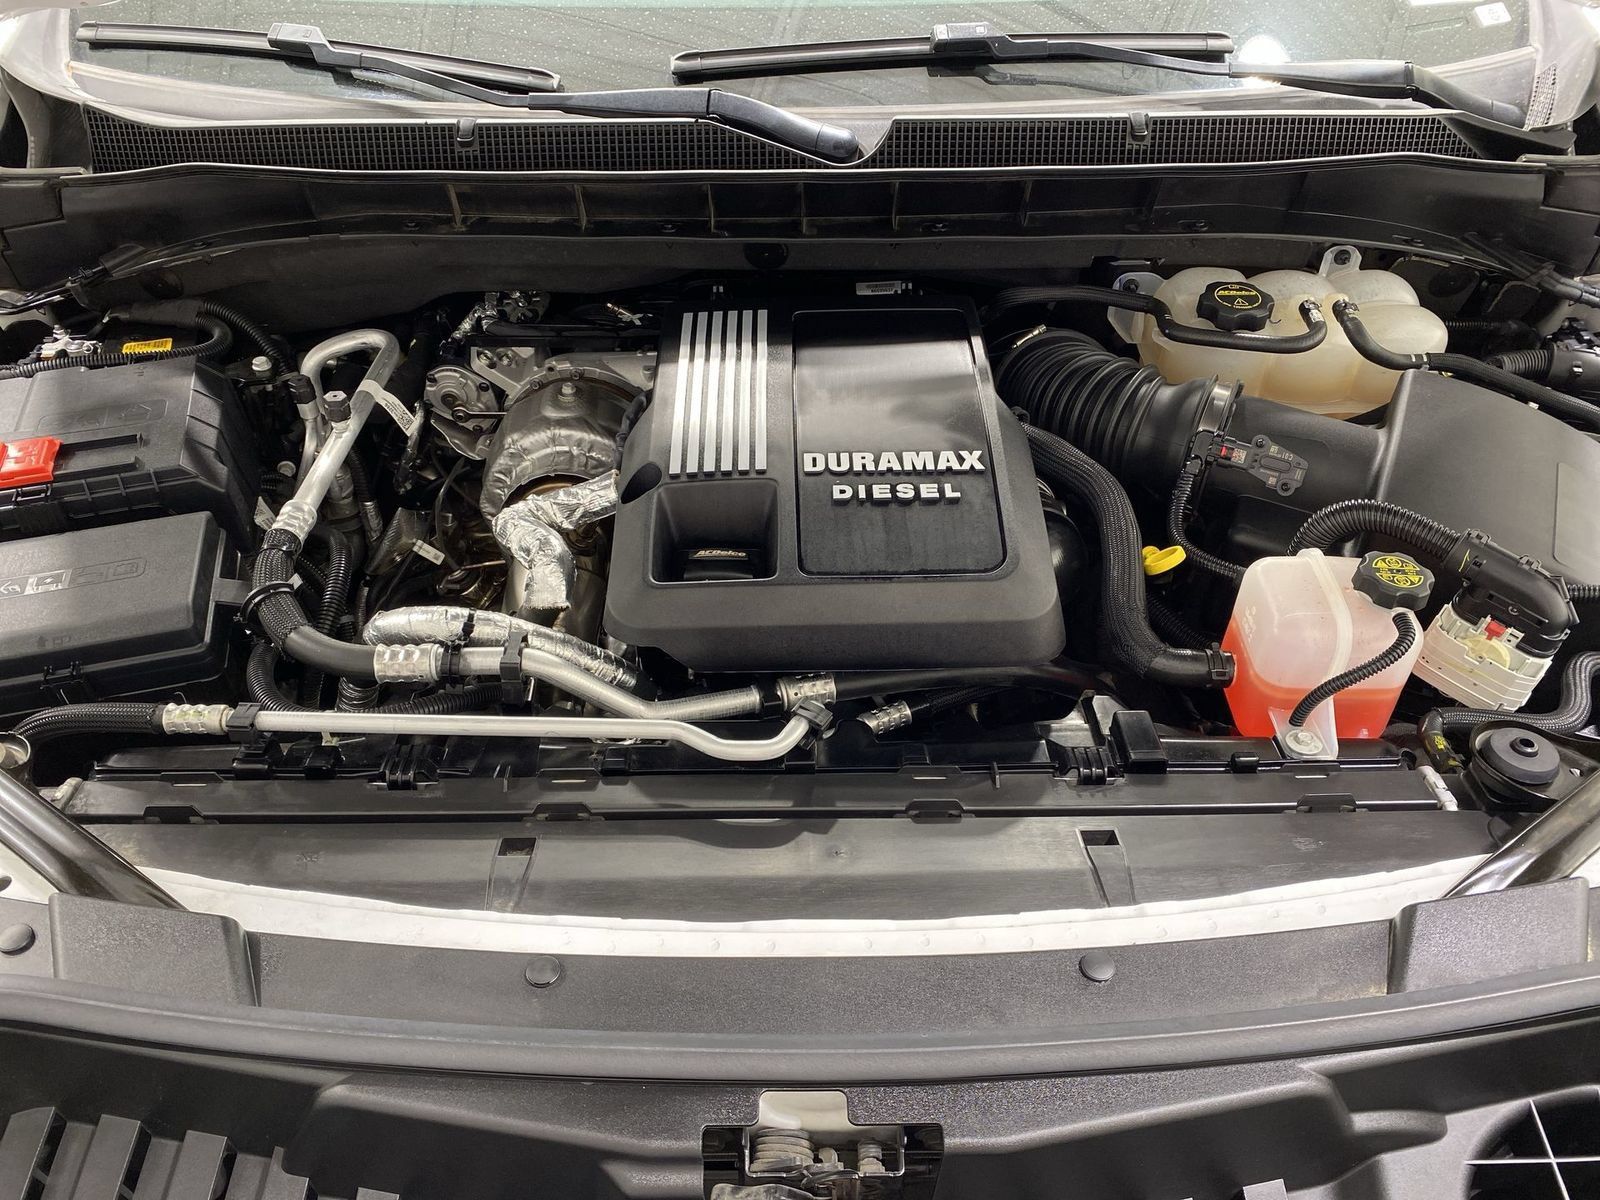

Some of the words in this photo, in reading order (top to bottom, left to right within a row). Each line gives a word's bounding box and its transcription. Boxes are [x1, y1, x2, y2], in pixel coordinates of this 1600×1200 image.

[803, 450, 985, 474] DURAMAX
[832, 484, 962, 502] DIESEL
[693, 549, 747, 558] ACDelco
